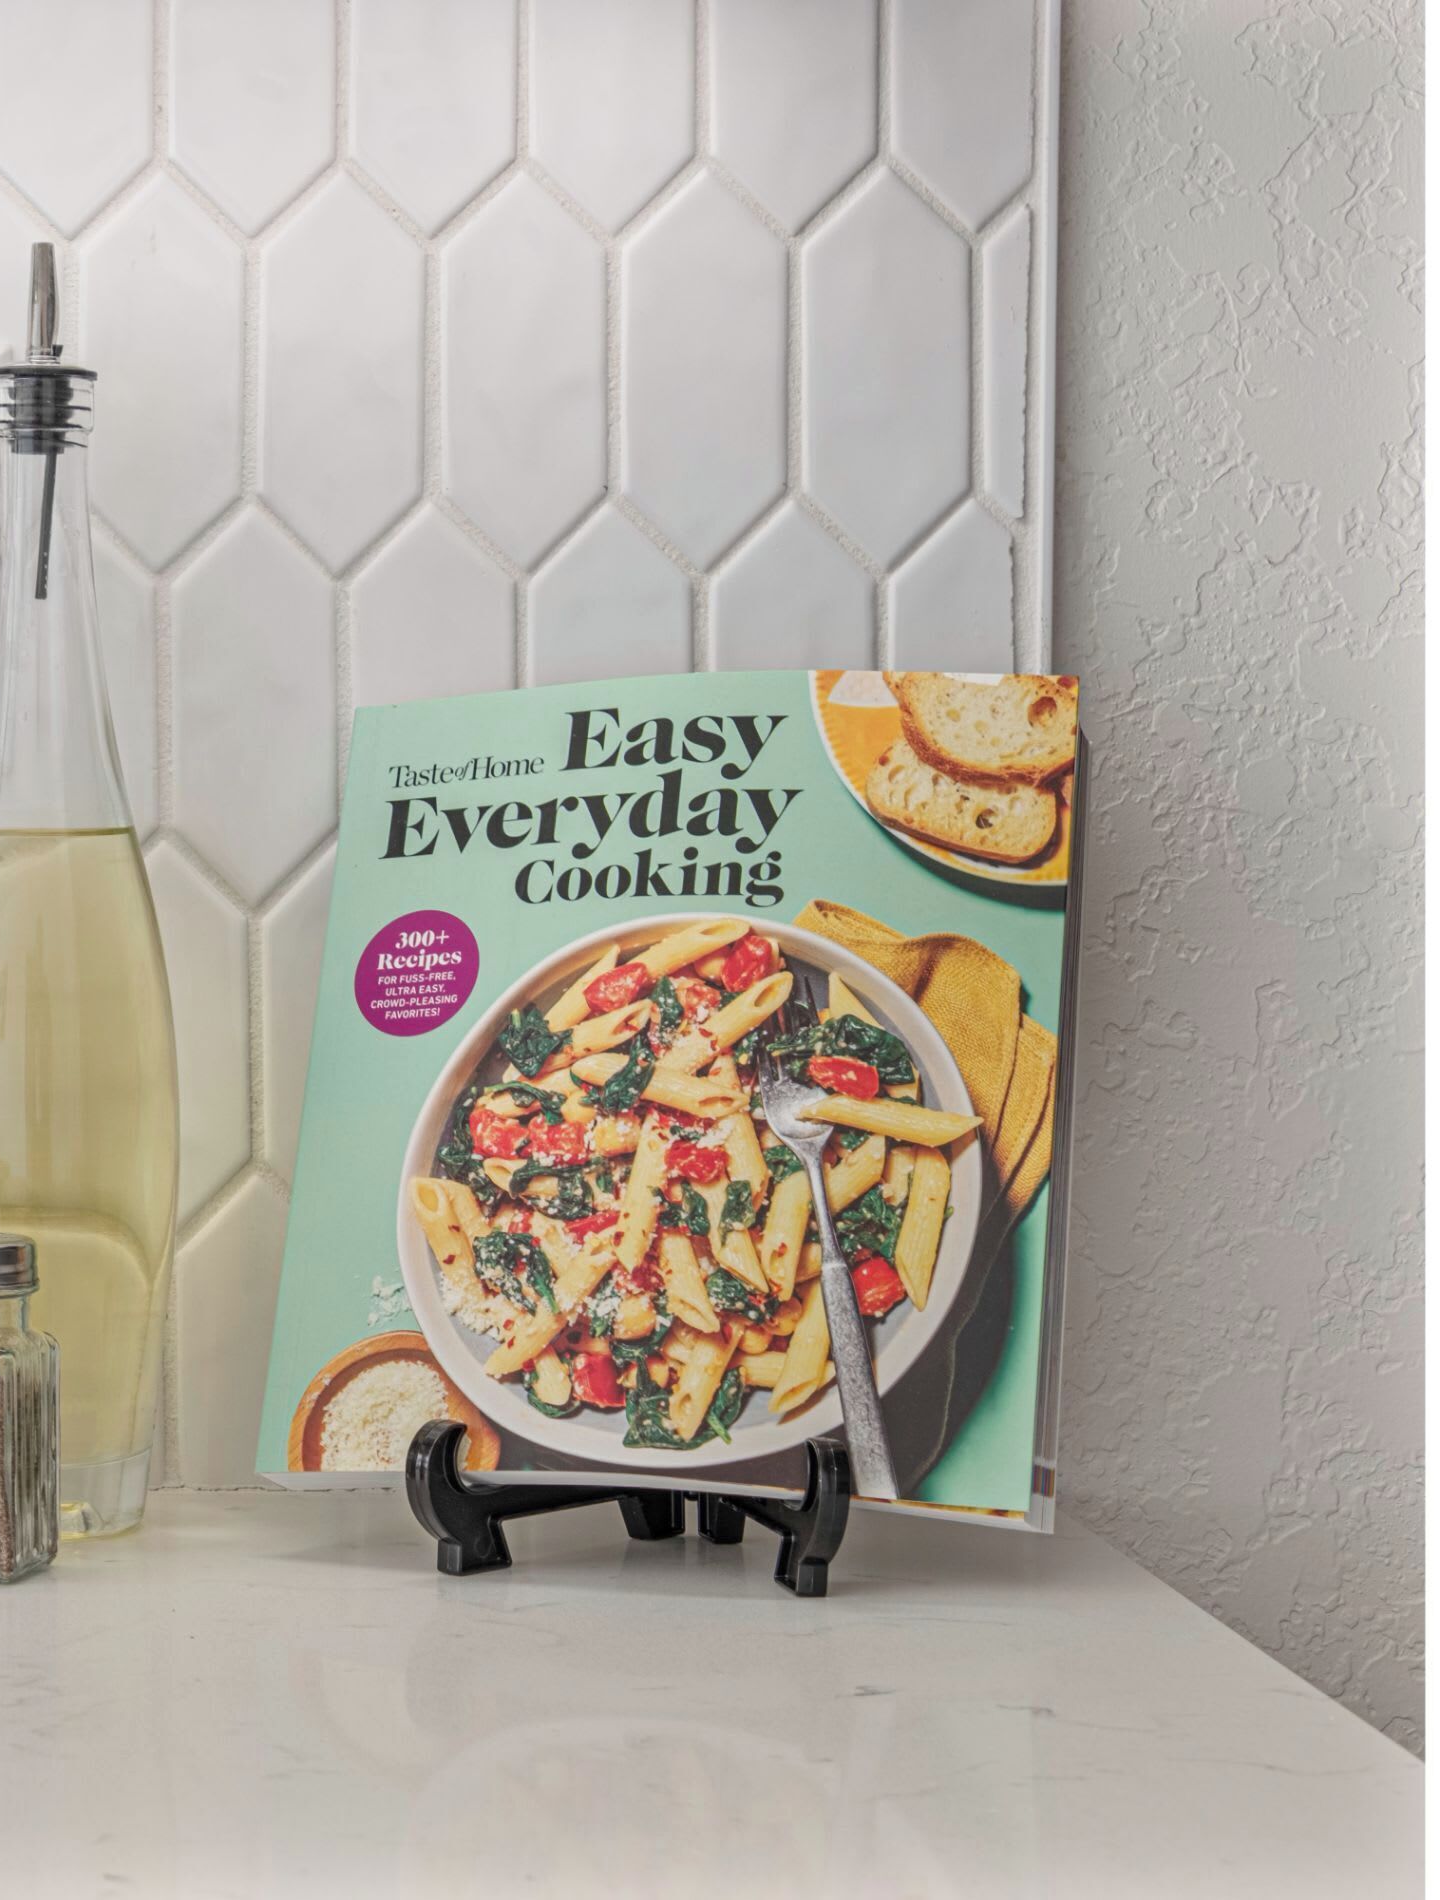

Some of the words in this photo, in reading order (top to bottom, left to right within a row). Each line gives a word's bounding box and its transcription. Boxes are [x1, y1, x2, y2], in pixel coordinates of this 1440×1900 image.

[559, 707, 789, 780] Easy
[378, 769, 804, 860] Everyday
[515, 846, 785, 908] Cooking
[395, 930, 450, 949] 300+
[377, 949, 462, 971] Recipes
[378, 976, 397, 985] FOR
[385, 986, 416, 996] ULTRA
[370, 994, 458, 1009] CROWD-PLEASING
[385, 1007, 441, 1020] FAVORITES!
